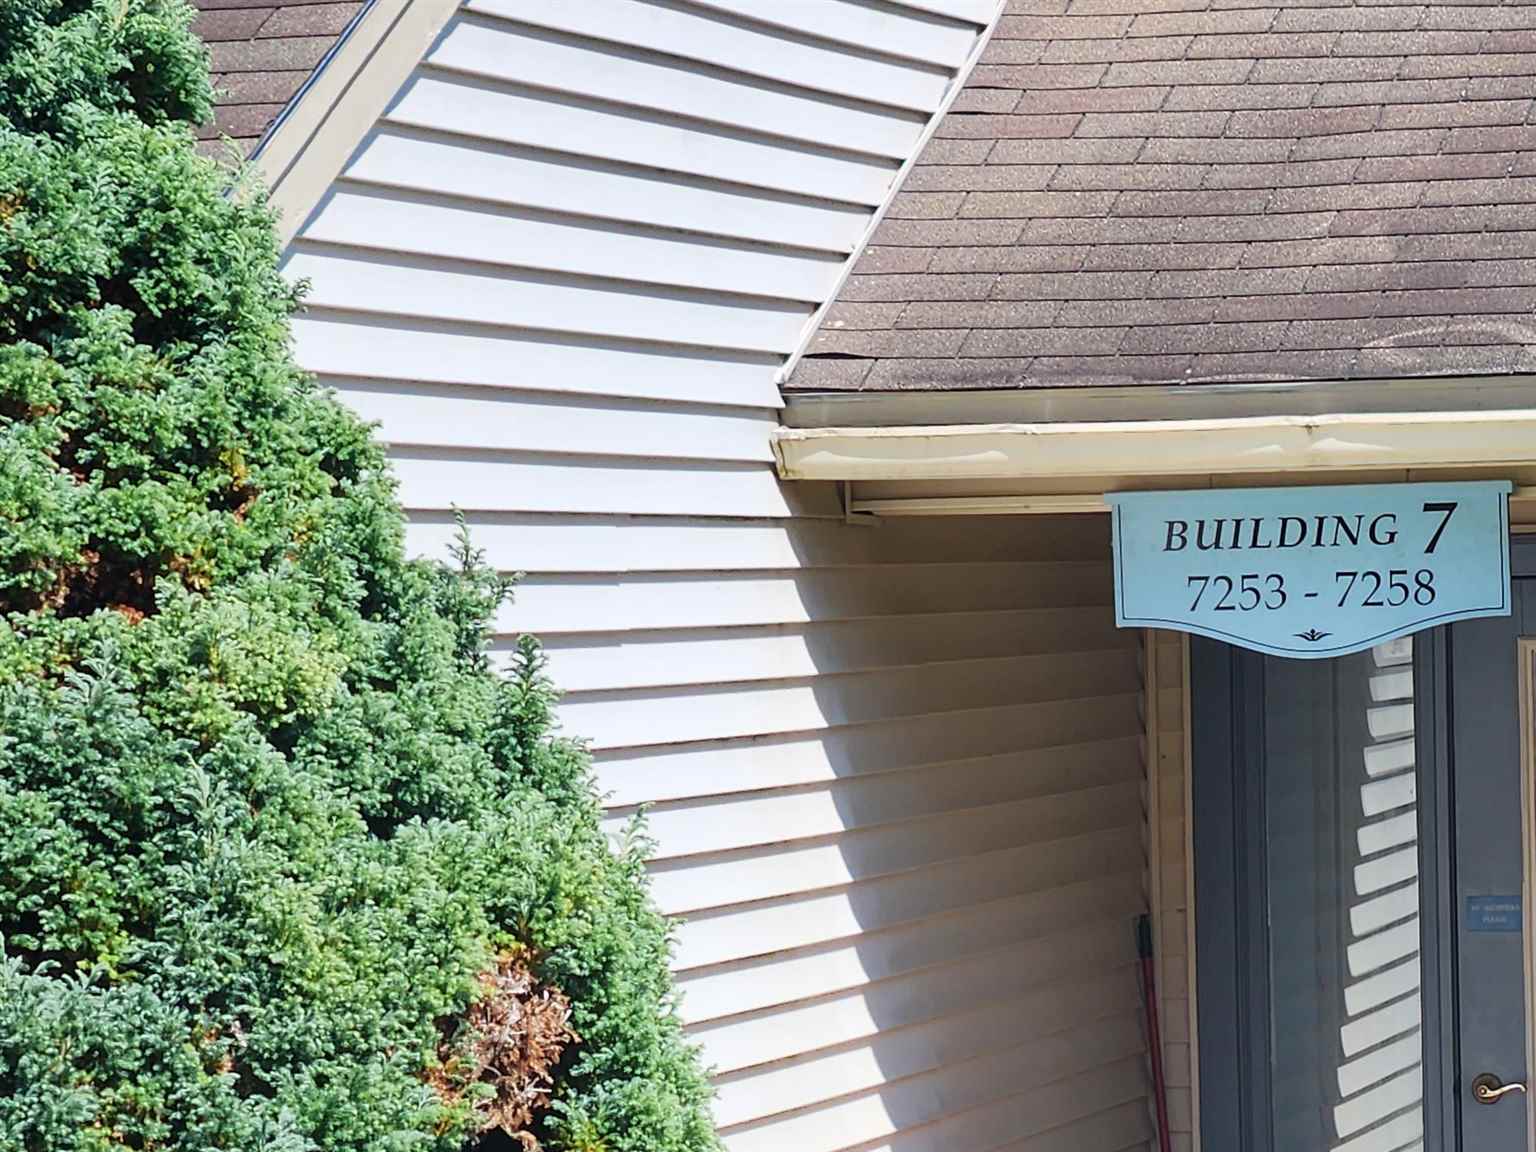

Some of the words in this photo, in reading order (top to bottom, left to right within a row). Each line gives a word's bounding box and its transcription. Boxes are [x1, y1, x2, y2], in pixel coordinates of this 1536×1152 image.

[1163, 513, 1398, 551] BUILDING
[1422, 502, 1458, 554] 7
[1187, 574, 1287, 611] 7253
[1335, 569, 1436, 607] 7258
